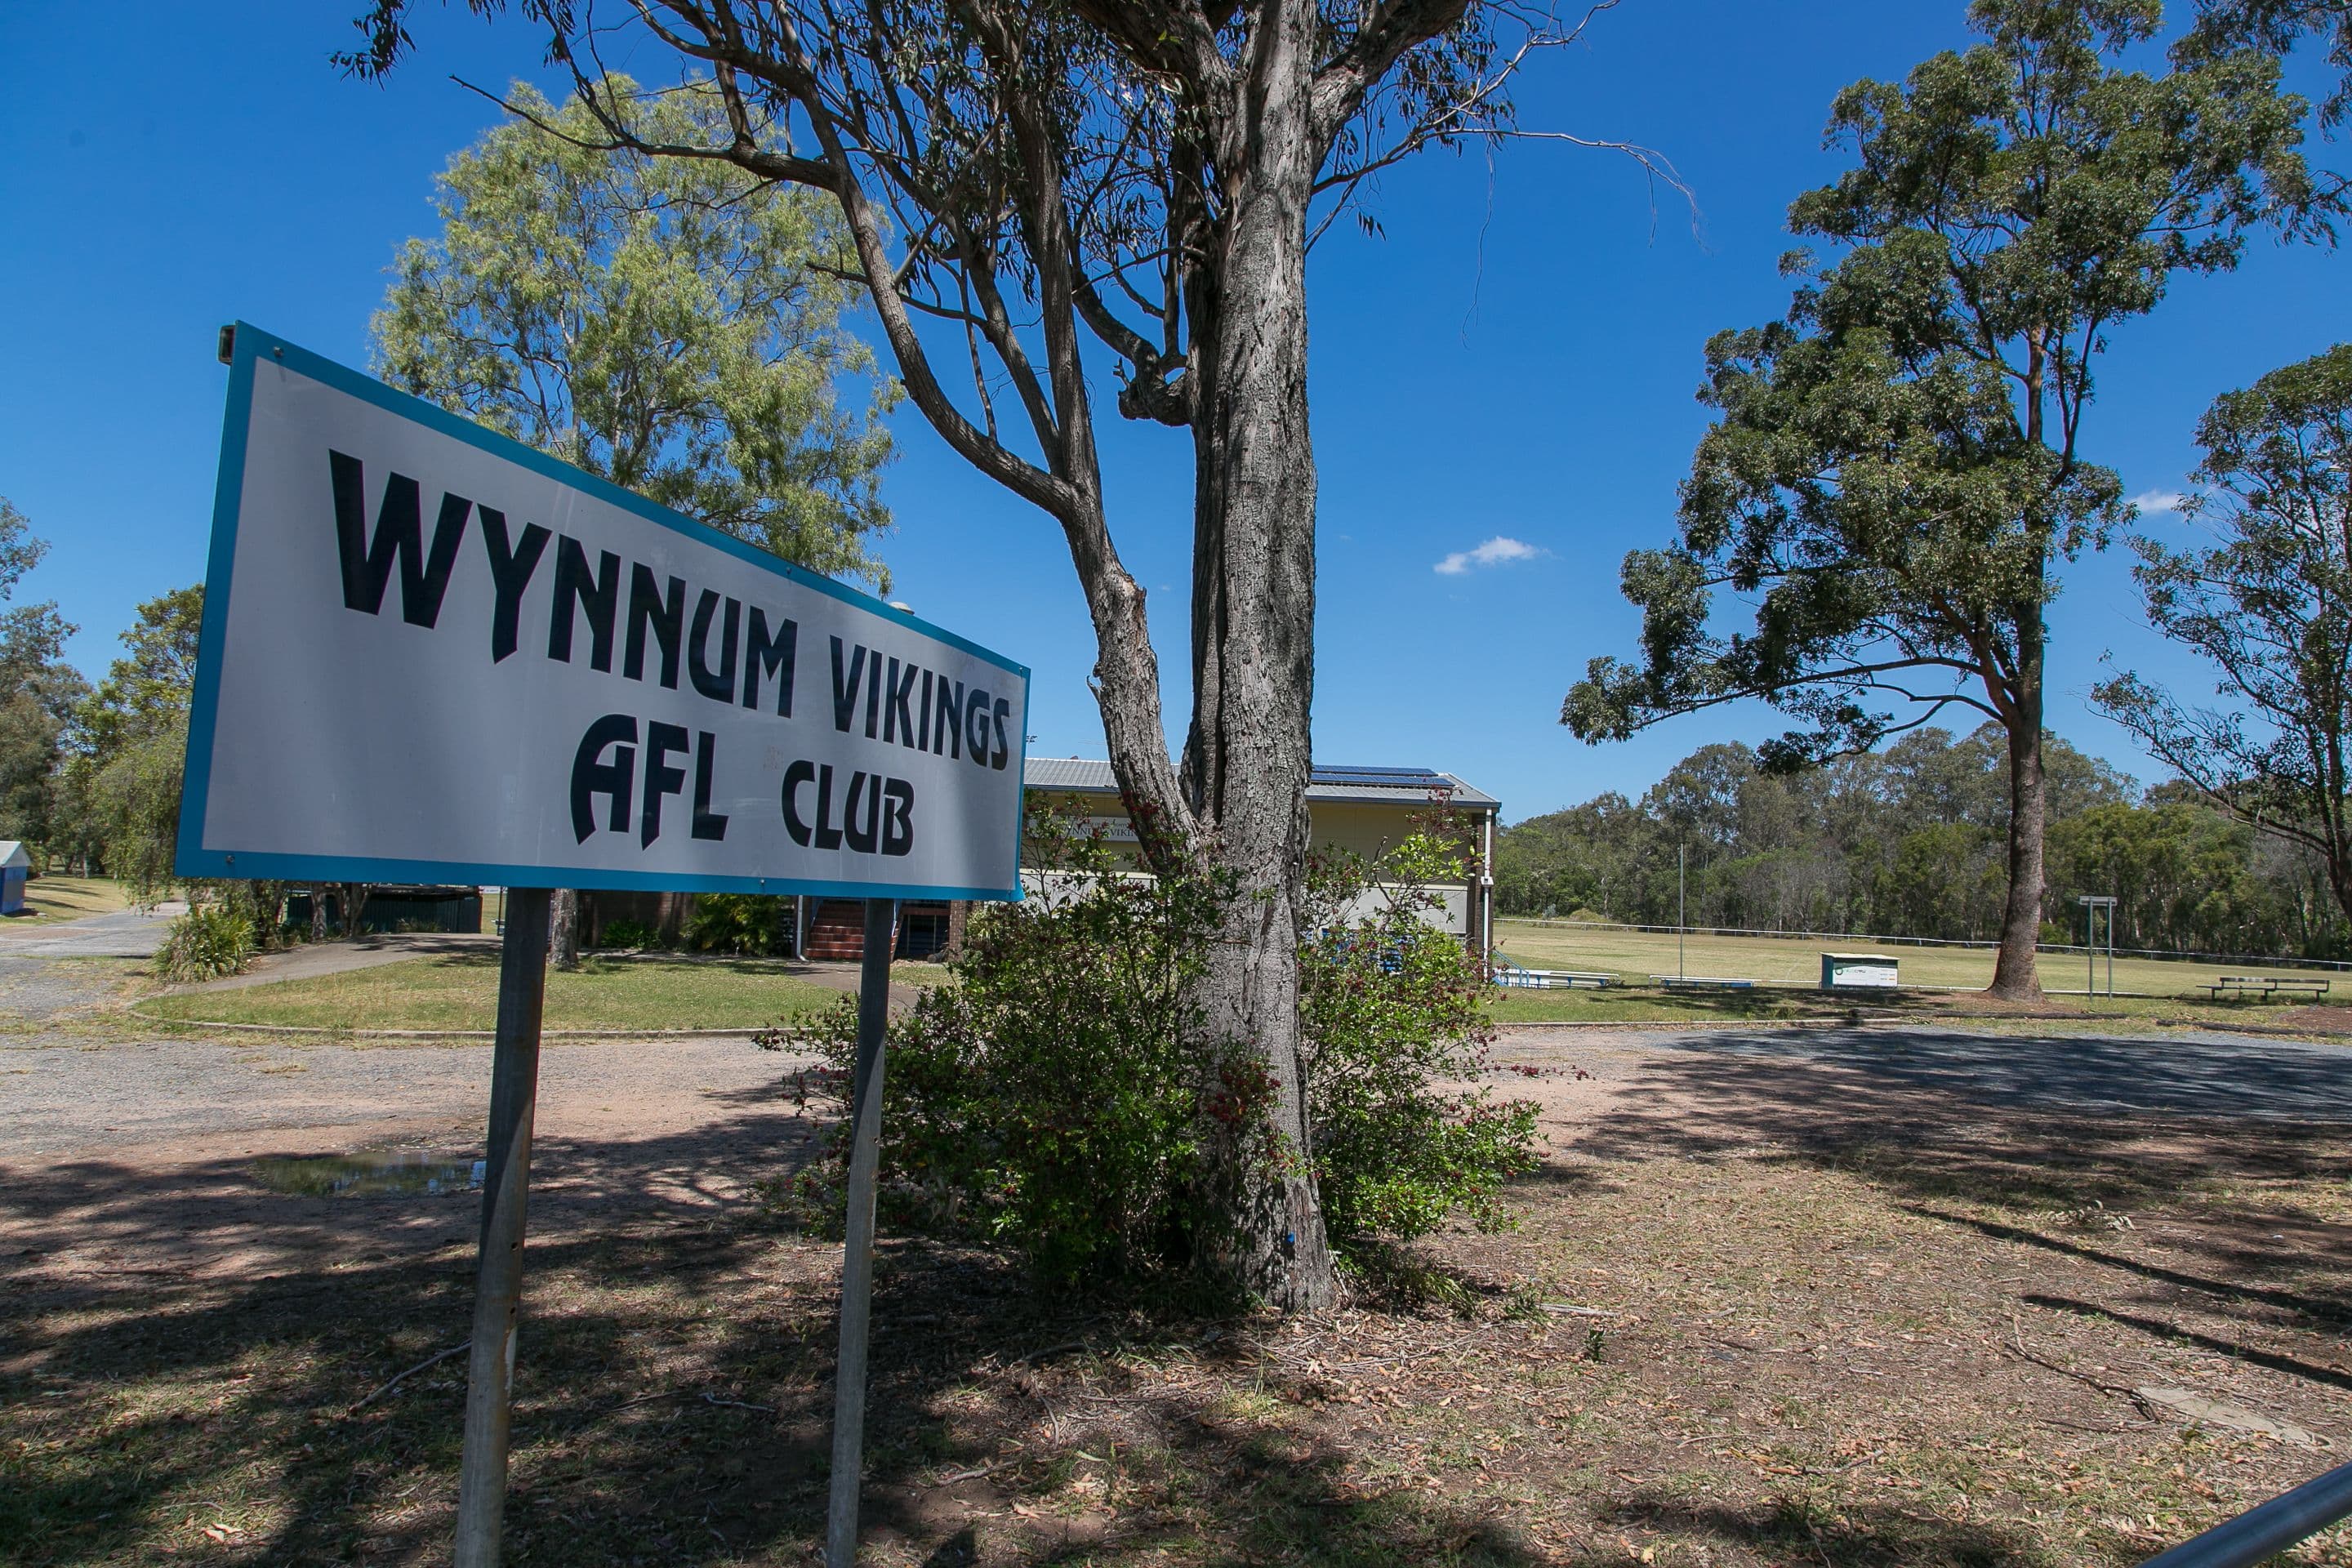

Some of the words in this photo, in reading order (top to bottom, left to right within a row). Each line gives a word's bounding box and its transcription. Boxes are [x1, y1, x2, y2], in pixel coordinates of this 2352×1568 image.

[327, 448, 799, 719] WYNNUM
[829, 634, 1010, 772] VIKINGS
[570, 713, 729, 852] AFL
[781, 760, 915, 857] CLUB
